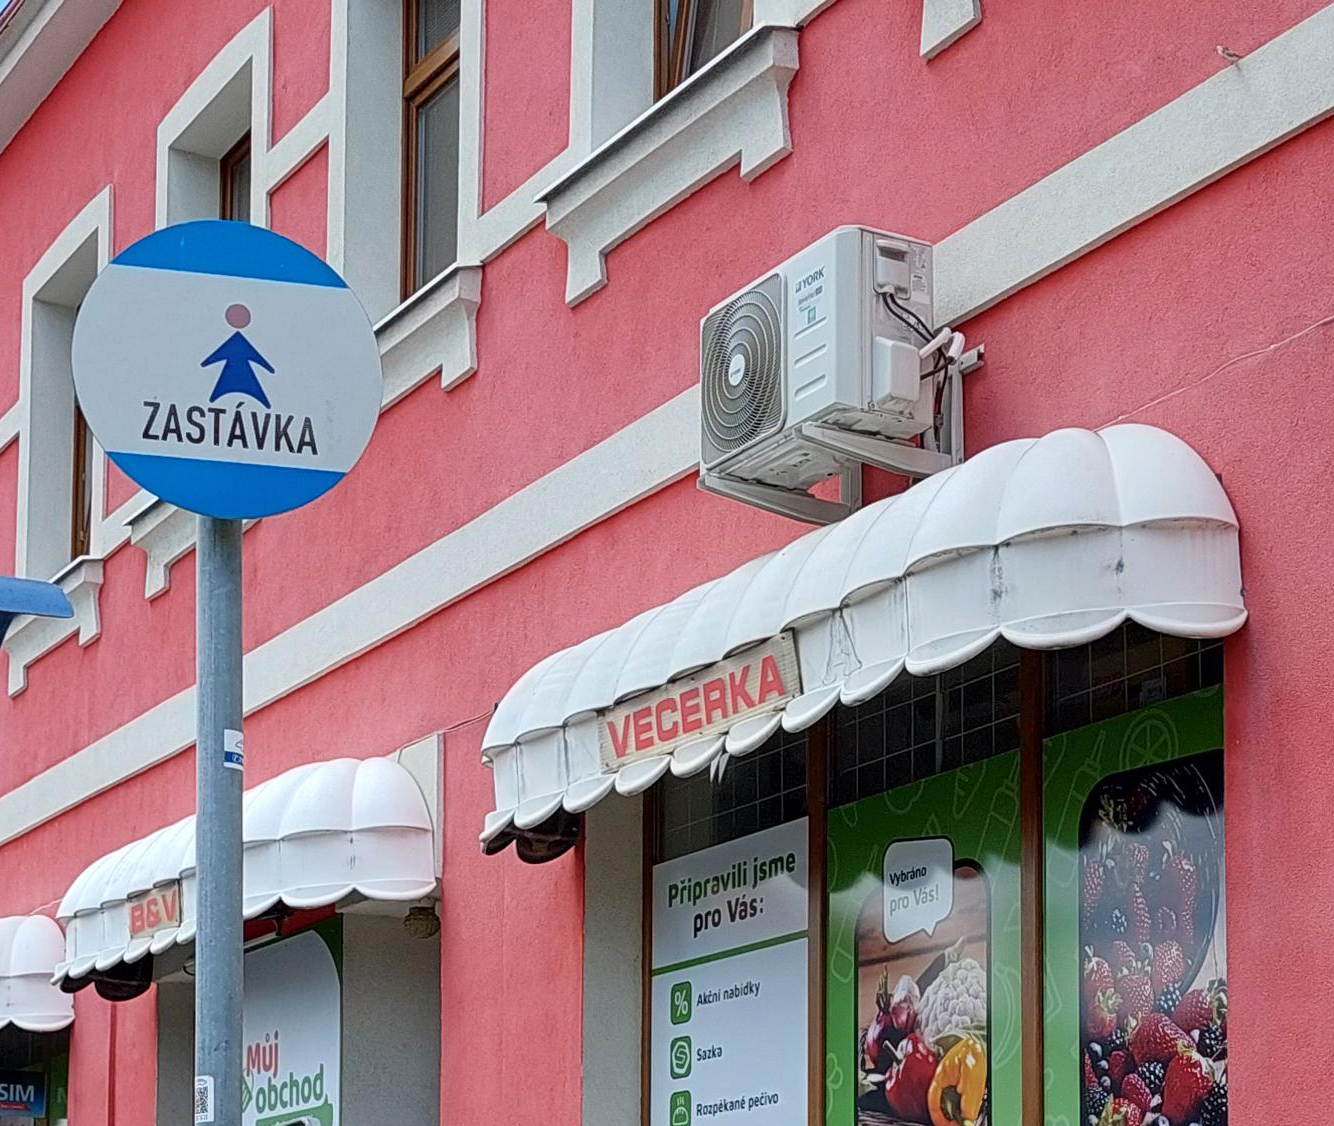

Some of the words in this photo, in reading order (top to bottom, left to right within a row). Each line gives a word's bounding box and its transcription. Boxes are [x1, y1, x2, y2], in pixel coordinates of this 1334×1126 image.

[802, 265, 826, 289] YORK
[142, 401, 319, 455] ZASTÁVKA
[607, 655, 787, 759] VECERKA
[668, 861, 748, 908] Připravili
[752, 852, 796, 889] jsme
[889, 866, 927, 887] Vybráno
[131, 889, 177, 935] B&V
[693, 908, 722, 938] pro
[727, 894, 764, 923] Vás:
[890, 895, 910, 917] pro
[913, 883, 940, 906] Vás!
[696, 988, 722, 1007] Akční
[723, 981, 761, 1000] nabídky
[247, 1029, 279, 1079] Můj
[696, 1045, 723, 1061] Sazka
[255, 1063, 324, 1114] obchod
[696, 1095, 746, 1117] Rozpékané
[748, 1092, 779, 1111] pečivo
